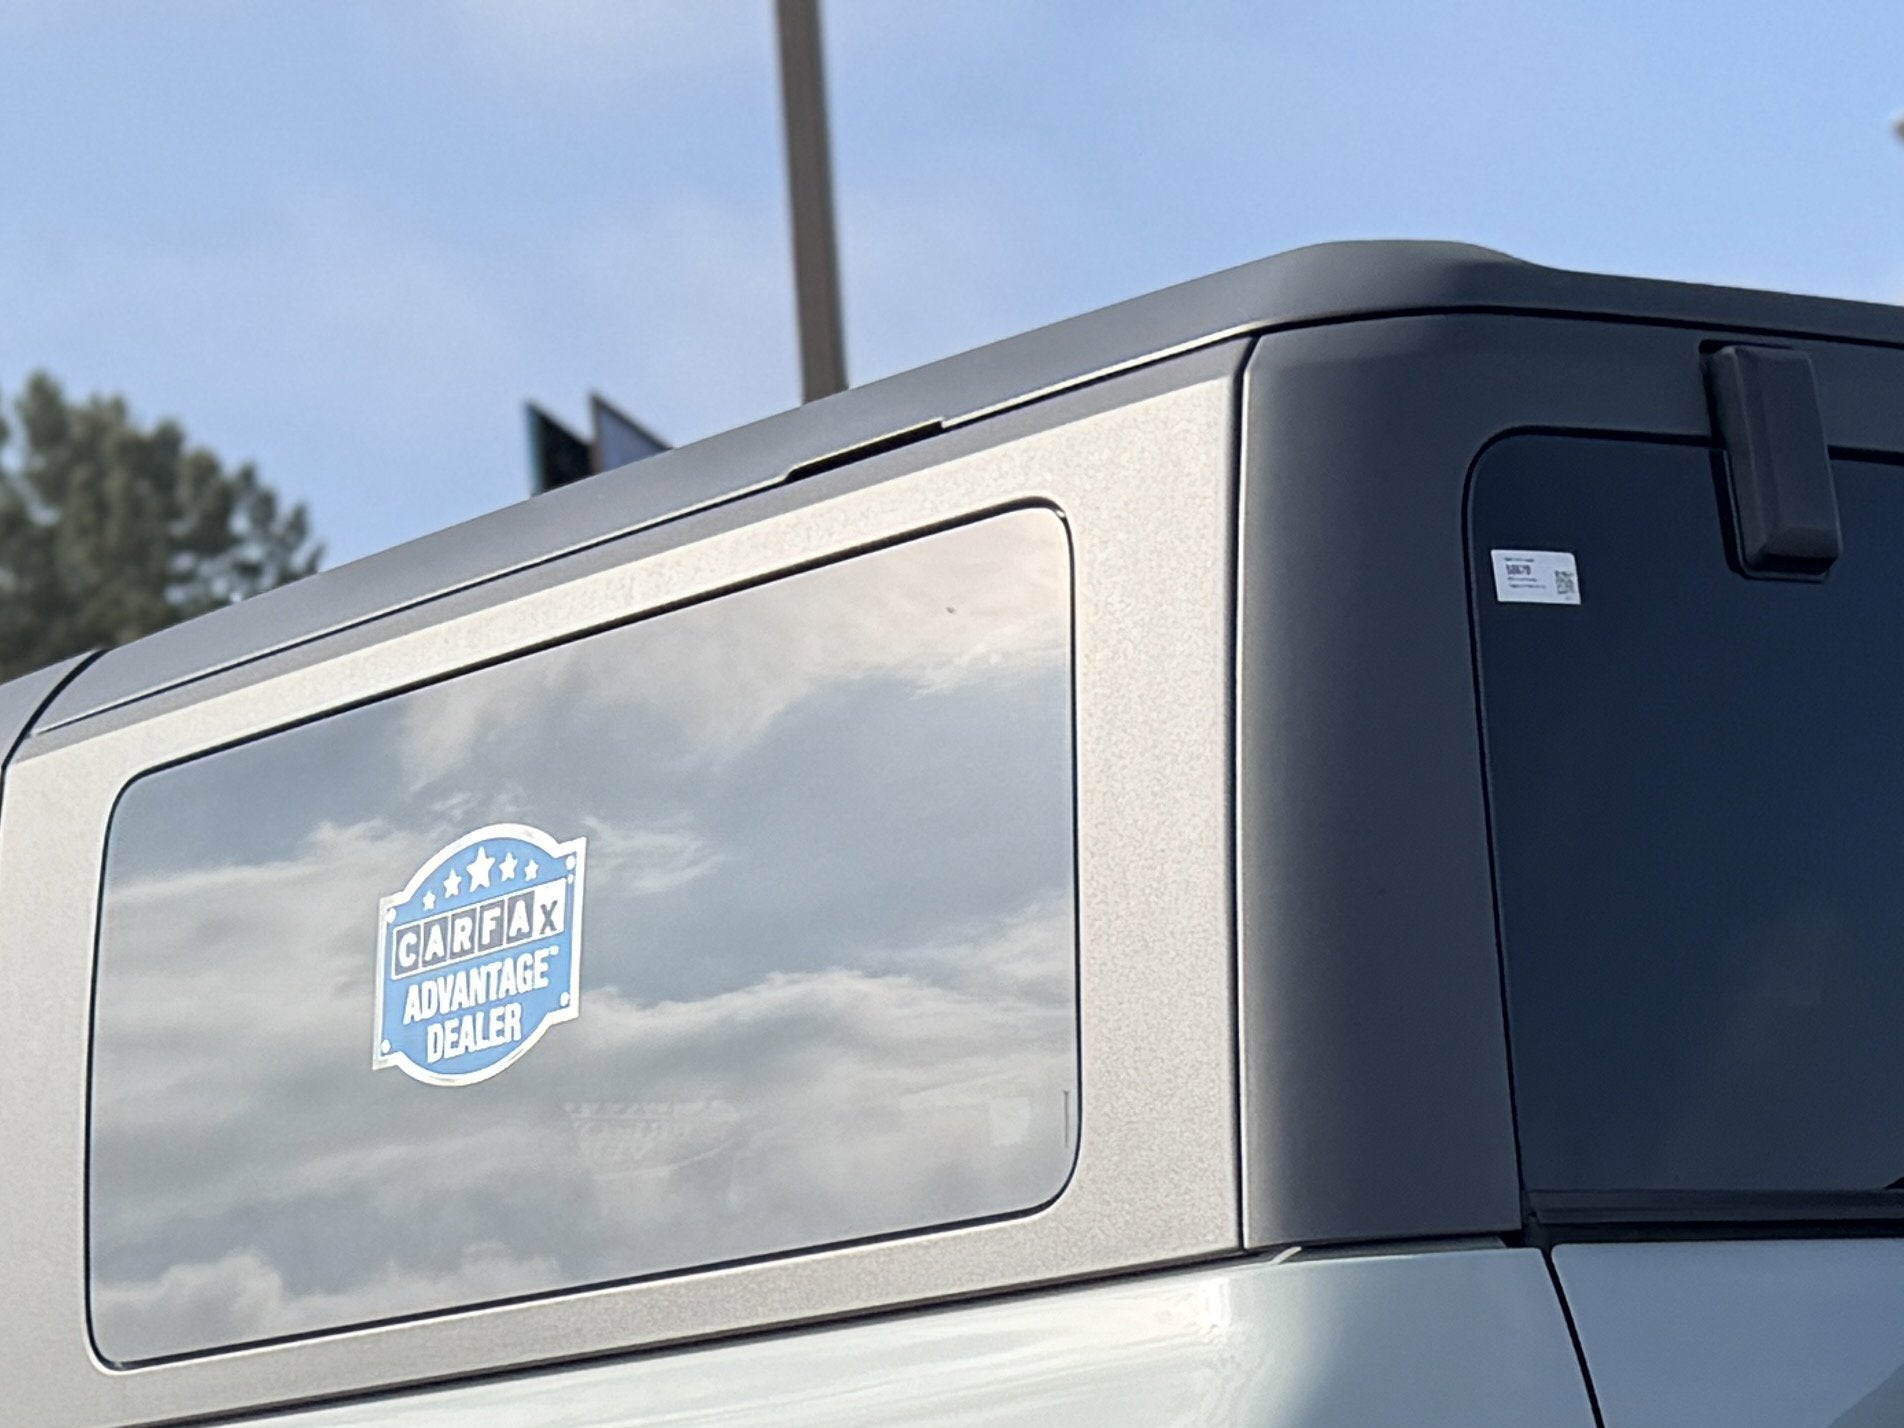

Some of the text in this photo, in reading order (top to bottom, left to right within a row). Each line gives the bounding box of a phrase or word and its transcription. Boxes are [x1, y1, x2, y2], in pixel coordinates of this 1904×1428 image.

[396, 896, 560, 969] CARFAX
[402, 948, 550, 1025] ADVANTAGE
[427, 1002, 523, 1064] DEALER
